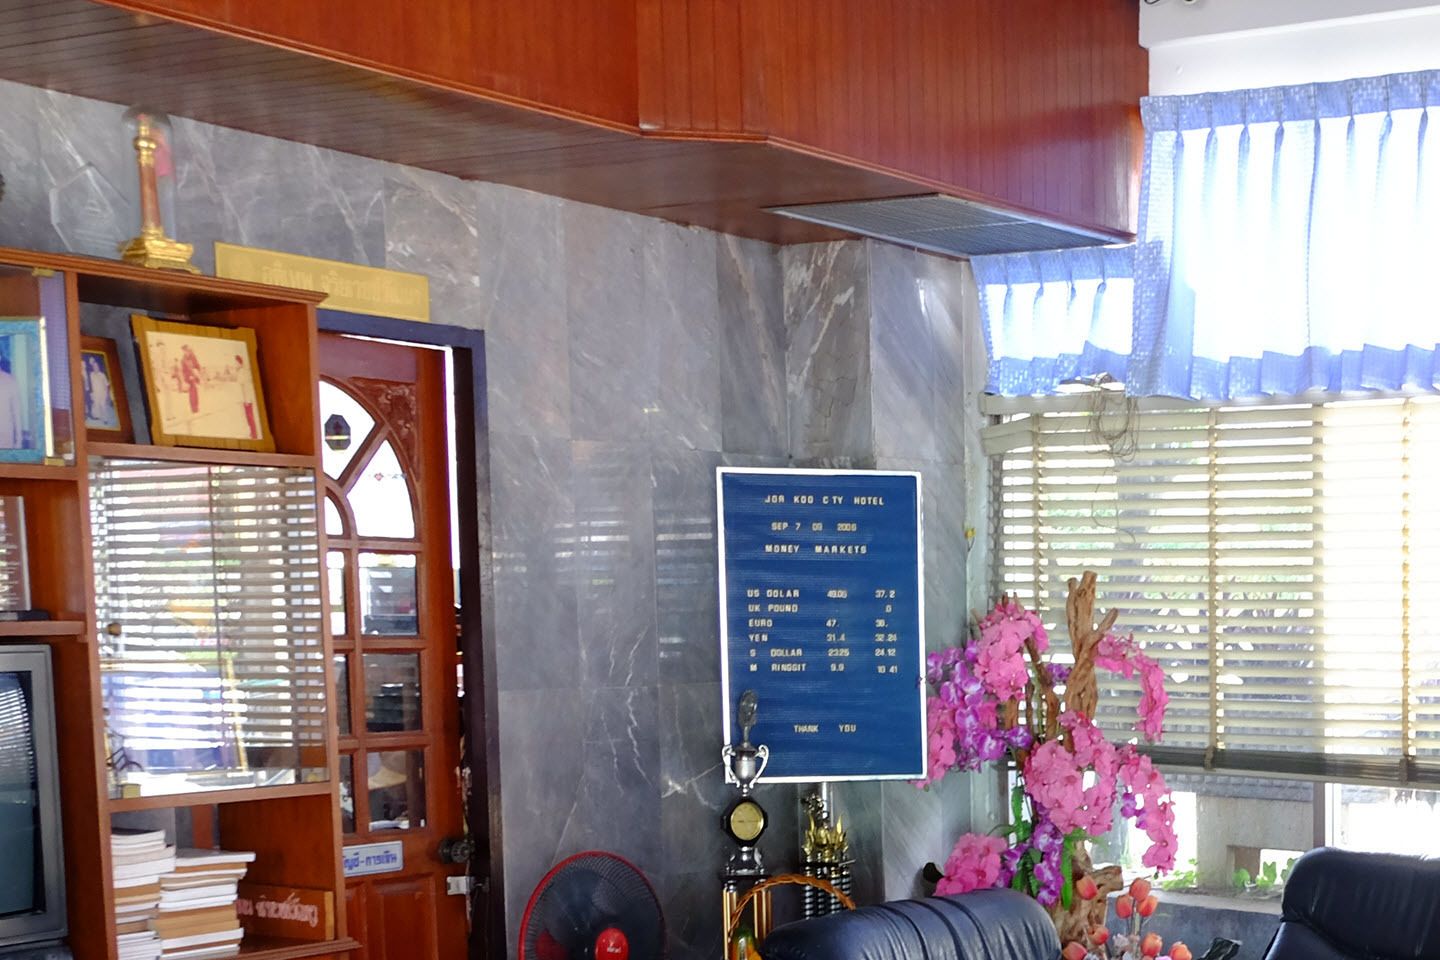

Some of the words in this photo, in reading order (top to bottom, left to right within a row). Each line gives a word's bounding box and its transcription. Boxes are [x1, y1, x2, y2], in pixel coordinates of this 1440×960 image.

[854, 496, 885, 506] HOTEL
[772, 521, 789, 532] SEP
[796, 522, 801, 532] 7
[765, 544, 800, 554] MONEY
[815, 544, 868, 555] MARKETS
[747, 588, 760, 598] US
[767, 588, 800, 599] DOLAR
[749, 603, 761, 613] UK
[768, 603, 799, 613] POUND
[749, 618, 773, 628] EURO
[749, 633, 768, 642] YEN
[771, 648, 803, 658] DOLLAR
[750, 662, 758, 672] M
[772, 662, 807, 673] RINGGIT
[794, 724, 819, 733] THANK
[839, 724, 857, 733] YOU
